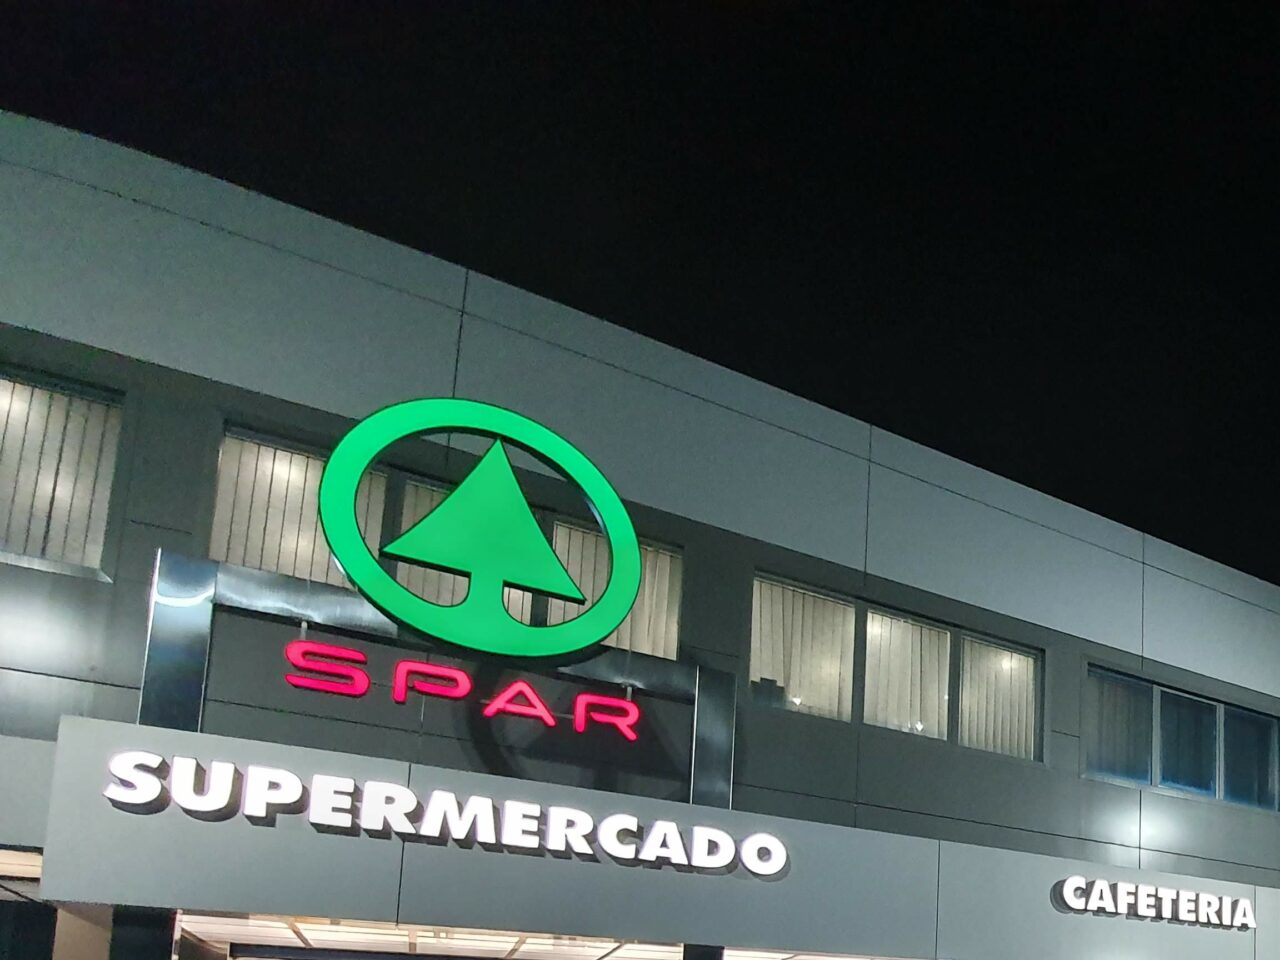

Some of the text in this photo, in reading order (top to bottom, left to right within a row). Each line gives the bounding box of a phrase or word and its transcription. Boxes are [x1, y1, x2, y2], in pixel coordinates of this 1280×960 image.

[283, 639, 641, 741] SPAR
[102, 749, 788, 876] SUPERMERCADO
[1061, 874, 1258, 929] CAFETERIA
